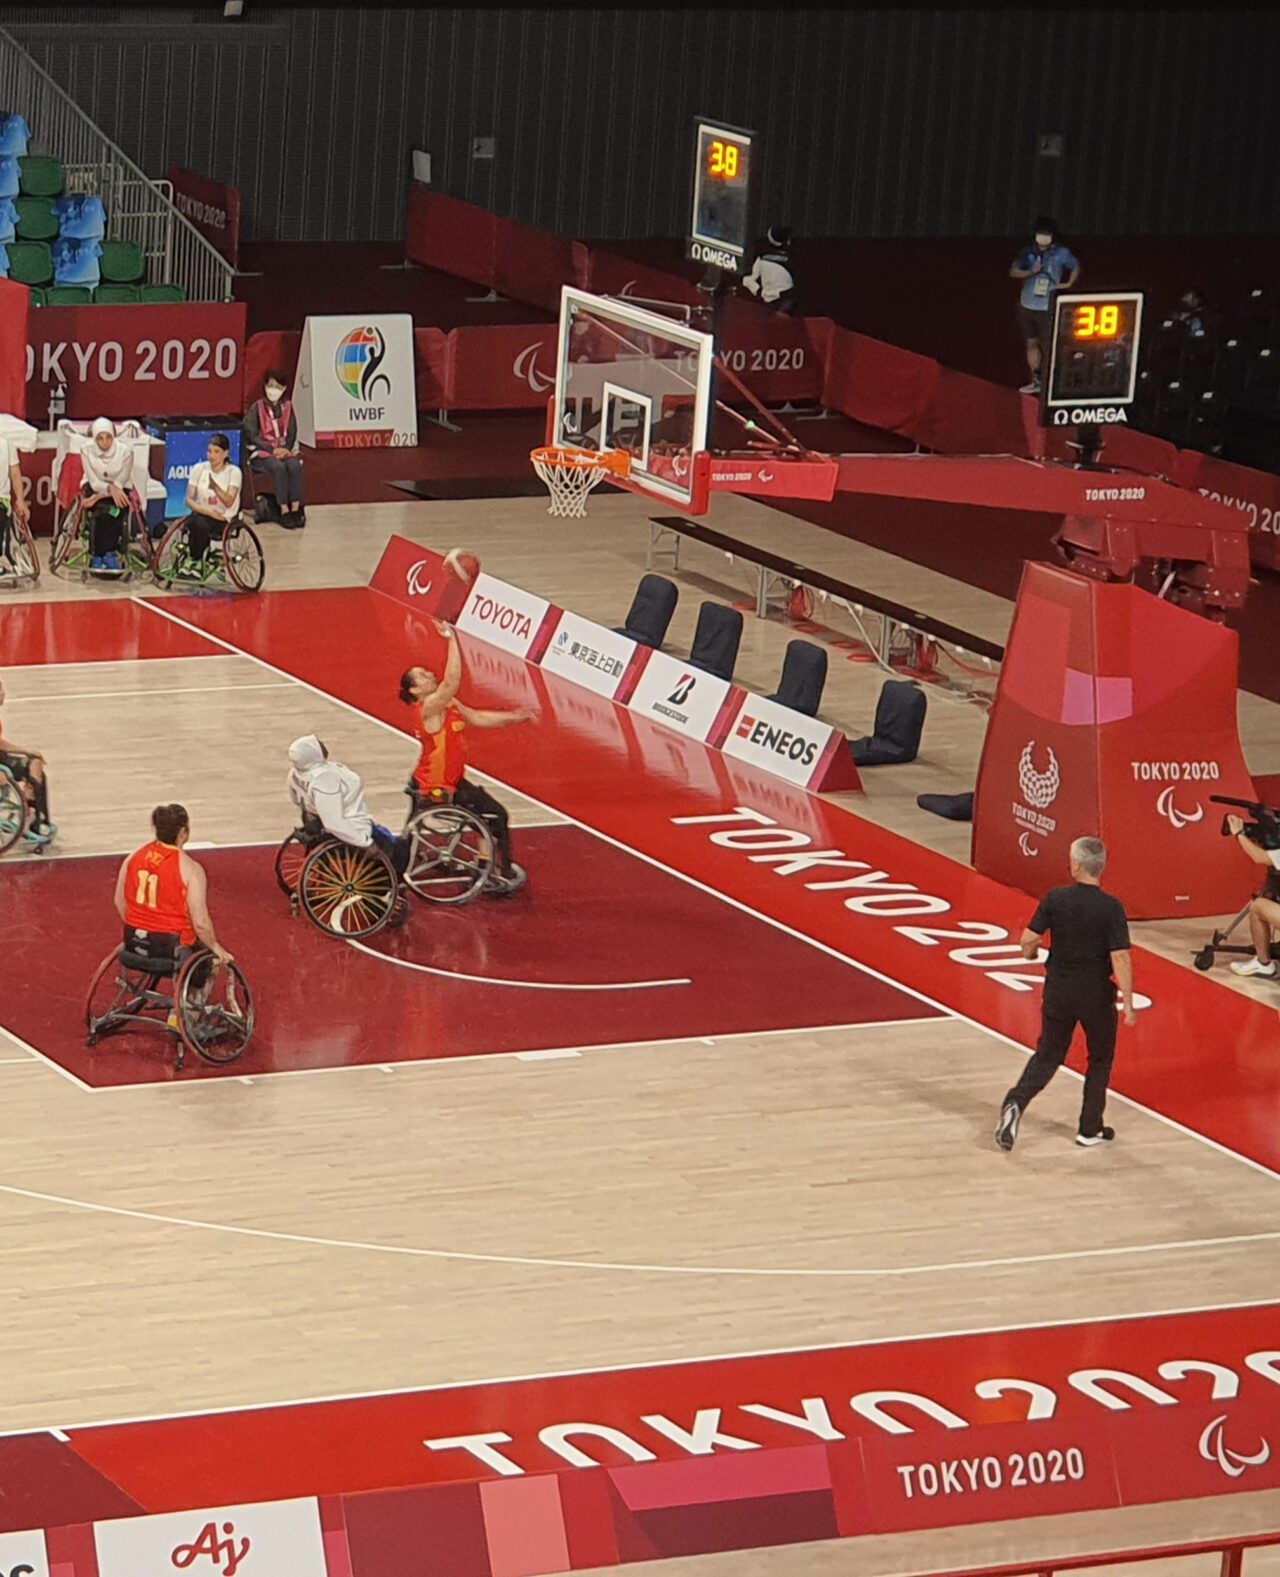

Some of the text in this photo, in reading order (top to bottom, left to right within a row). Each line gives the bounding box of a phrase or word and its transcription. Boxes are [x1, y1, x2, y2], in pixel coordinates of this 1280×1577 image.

[176, 192, 226, 229] TOKYO 2020
[702, 246, 738, 271] OMEGA
[1076, 305, 1118, 336] 3.8
[134, 338, 237, 381] 2020
[751, 348, 804, 371] 2020
[349, 407, 385, 421] IWBF
[1071, 406, 1128, 424] OMEGA
[337, 433, 417, 448] TOKYO 2020
[1085, 487, 1145, 501] TOKYO 2020
[471, 594, 532, 640] TOYOTA
[750, 721, 818, 765] ENEOS
[1131, 761, 1220, 780] TOKYO 2020
[670, 806, 952, 917] TOKYO
[135, 869, 159, 908] 11
[897, 1447, 1086, 1499] TOKYO 2020
